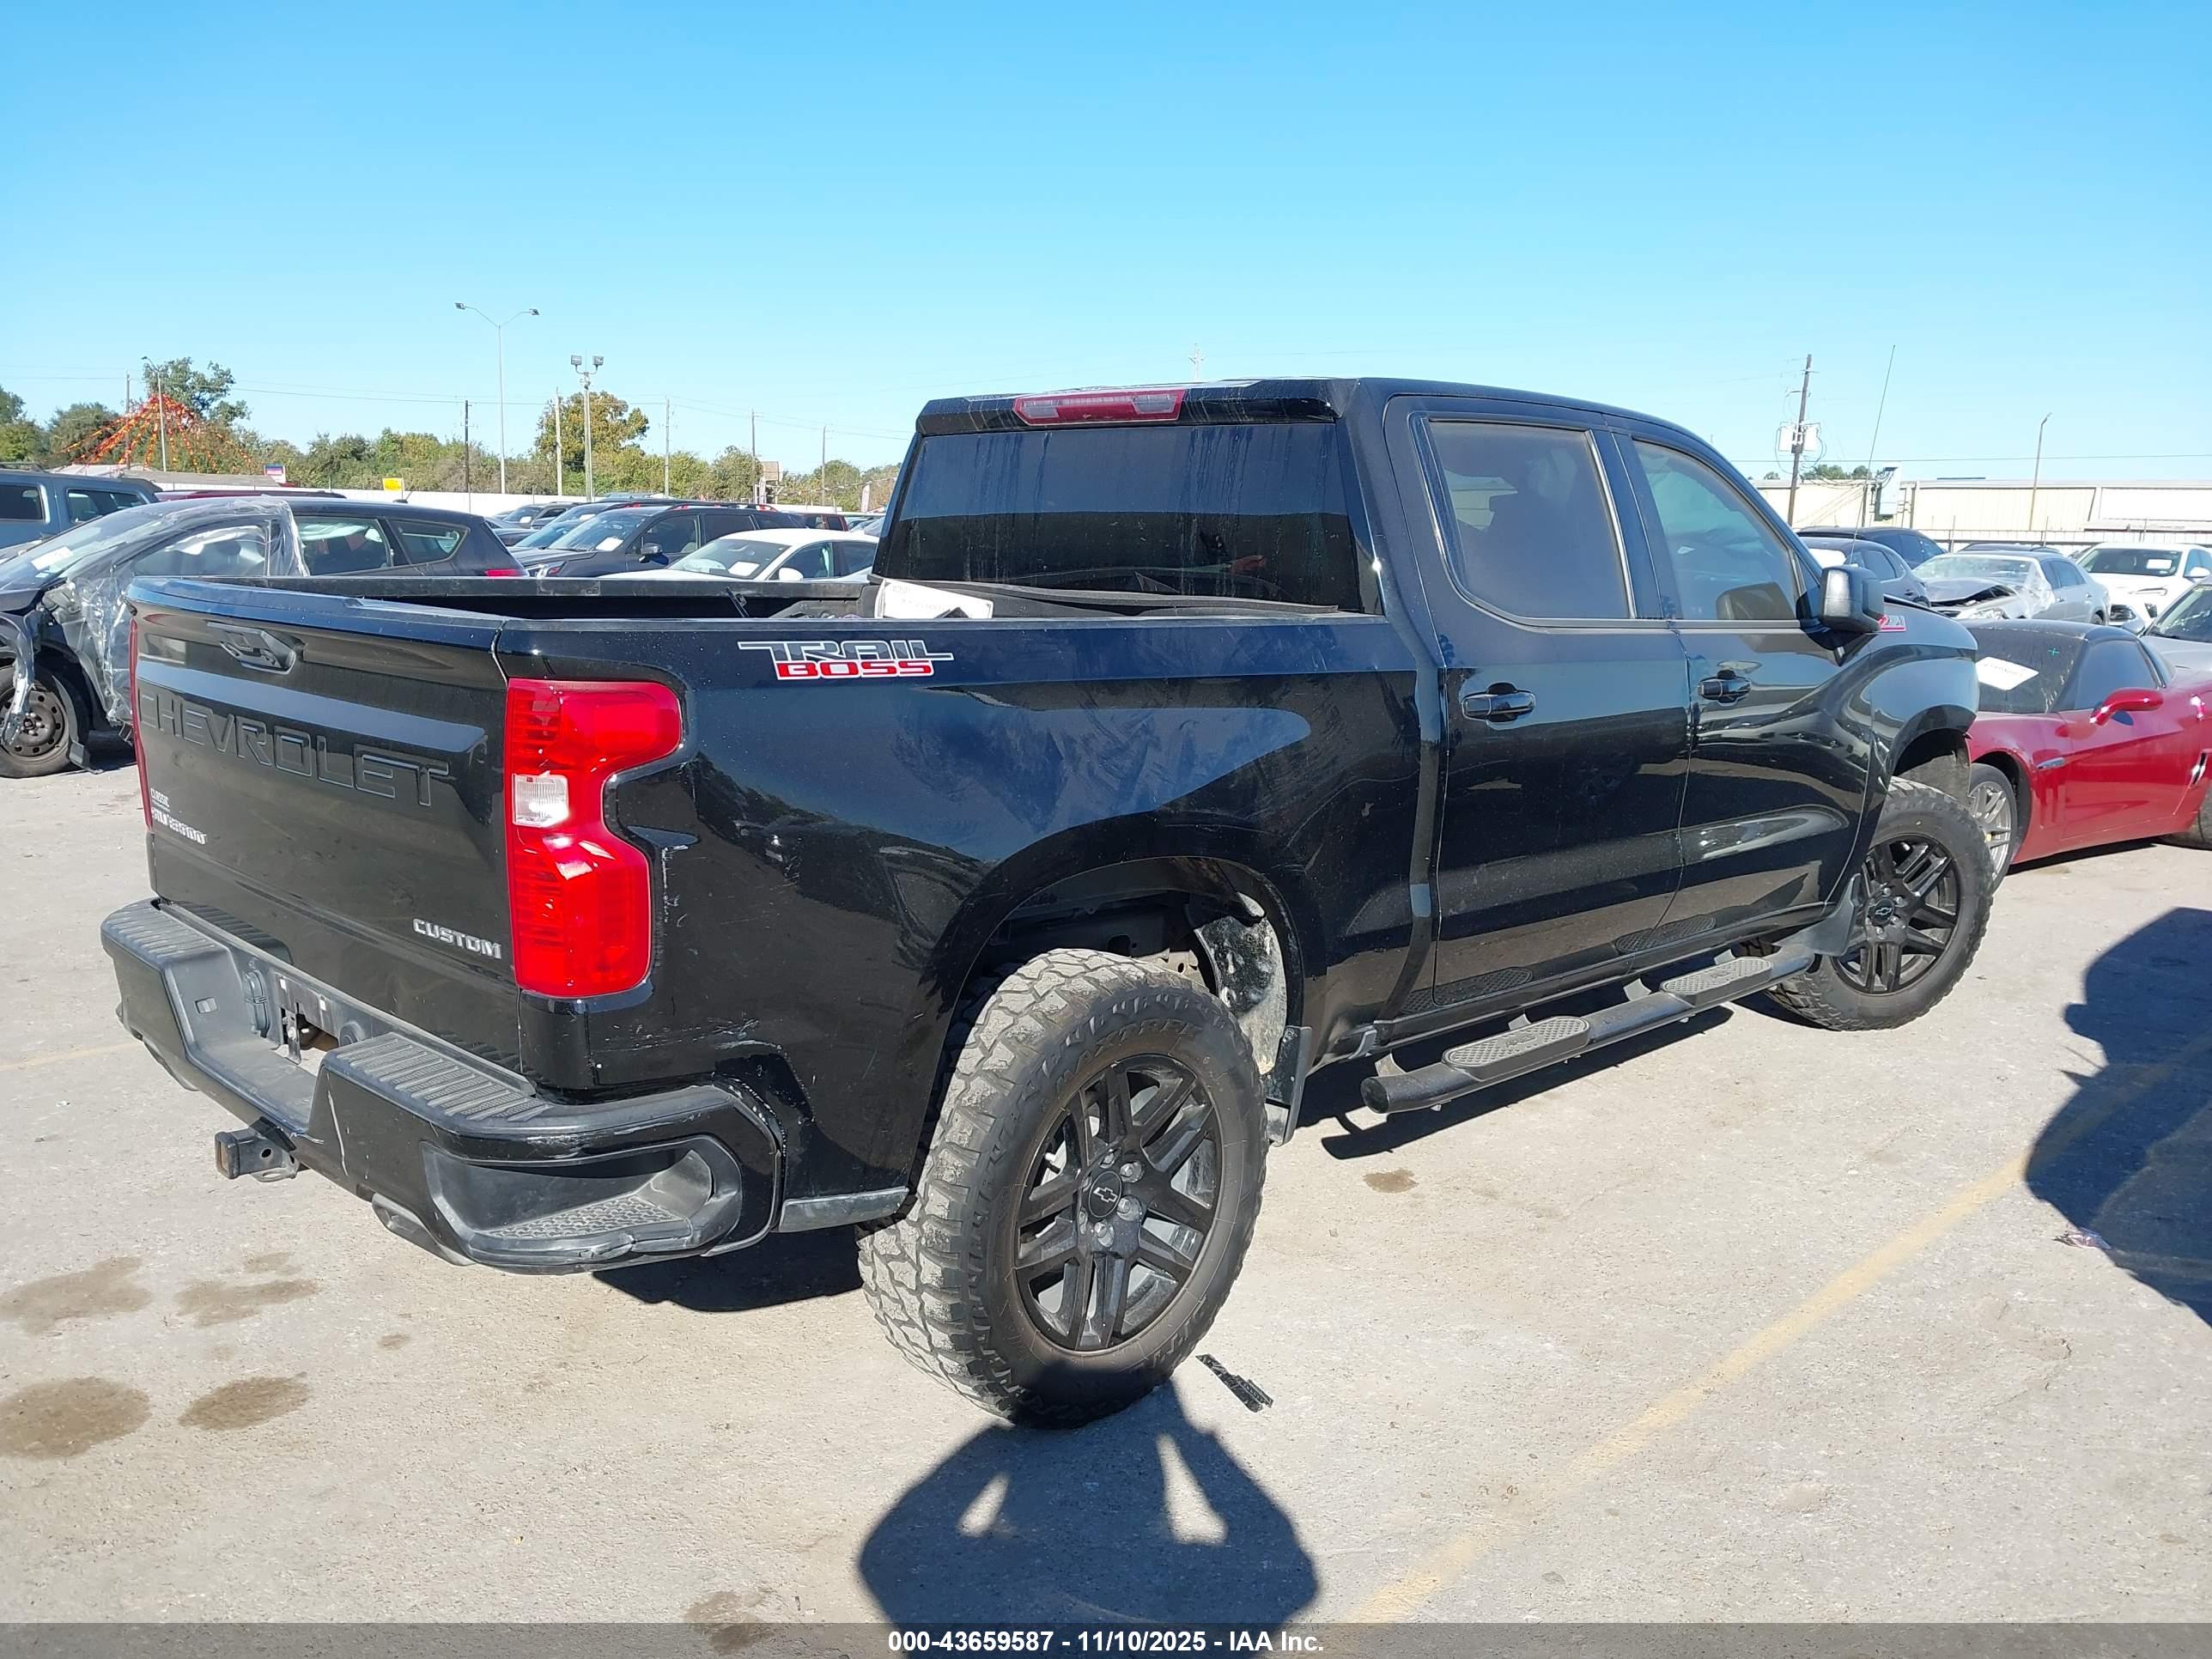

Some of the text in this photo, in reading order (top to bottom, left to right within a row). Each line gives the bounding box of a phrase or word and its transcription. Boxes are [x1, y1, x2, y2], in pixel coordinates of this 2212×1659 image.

[737, 640, 955, 661] TRAIL
[775, 659, 935, 680] BOSS
[137, 686, 450, 807] CHEVROLET
[413, 918, 502, 959] CUSTOM
